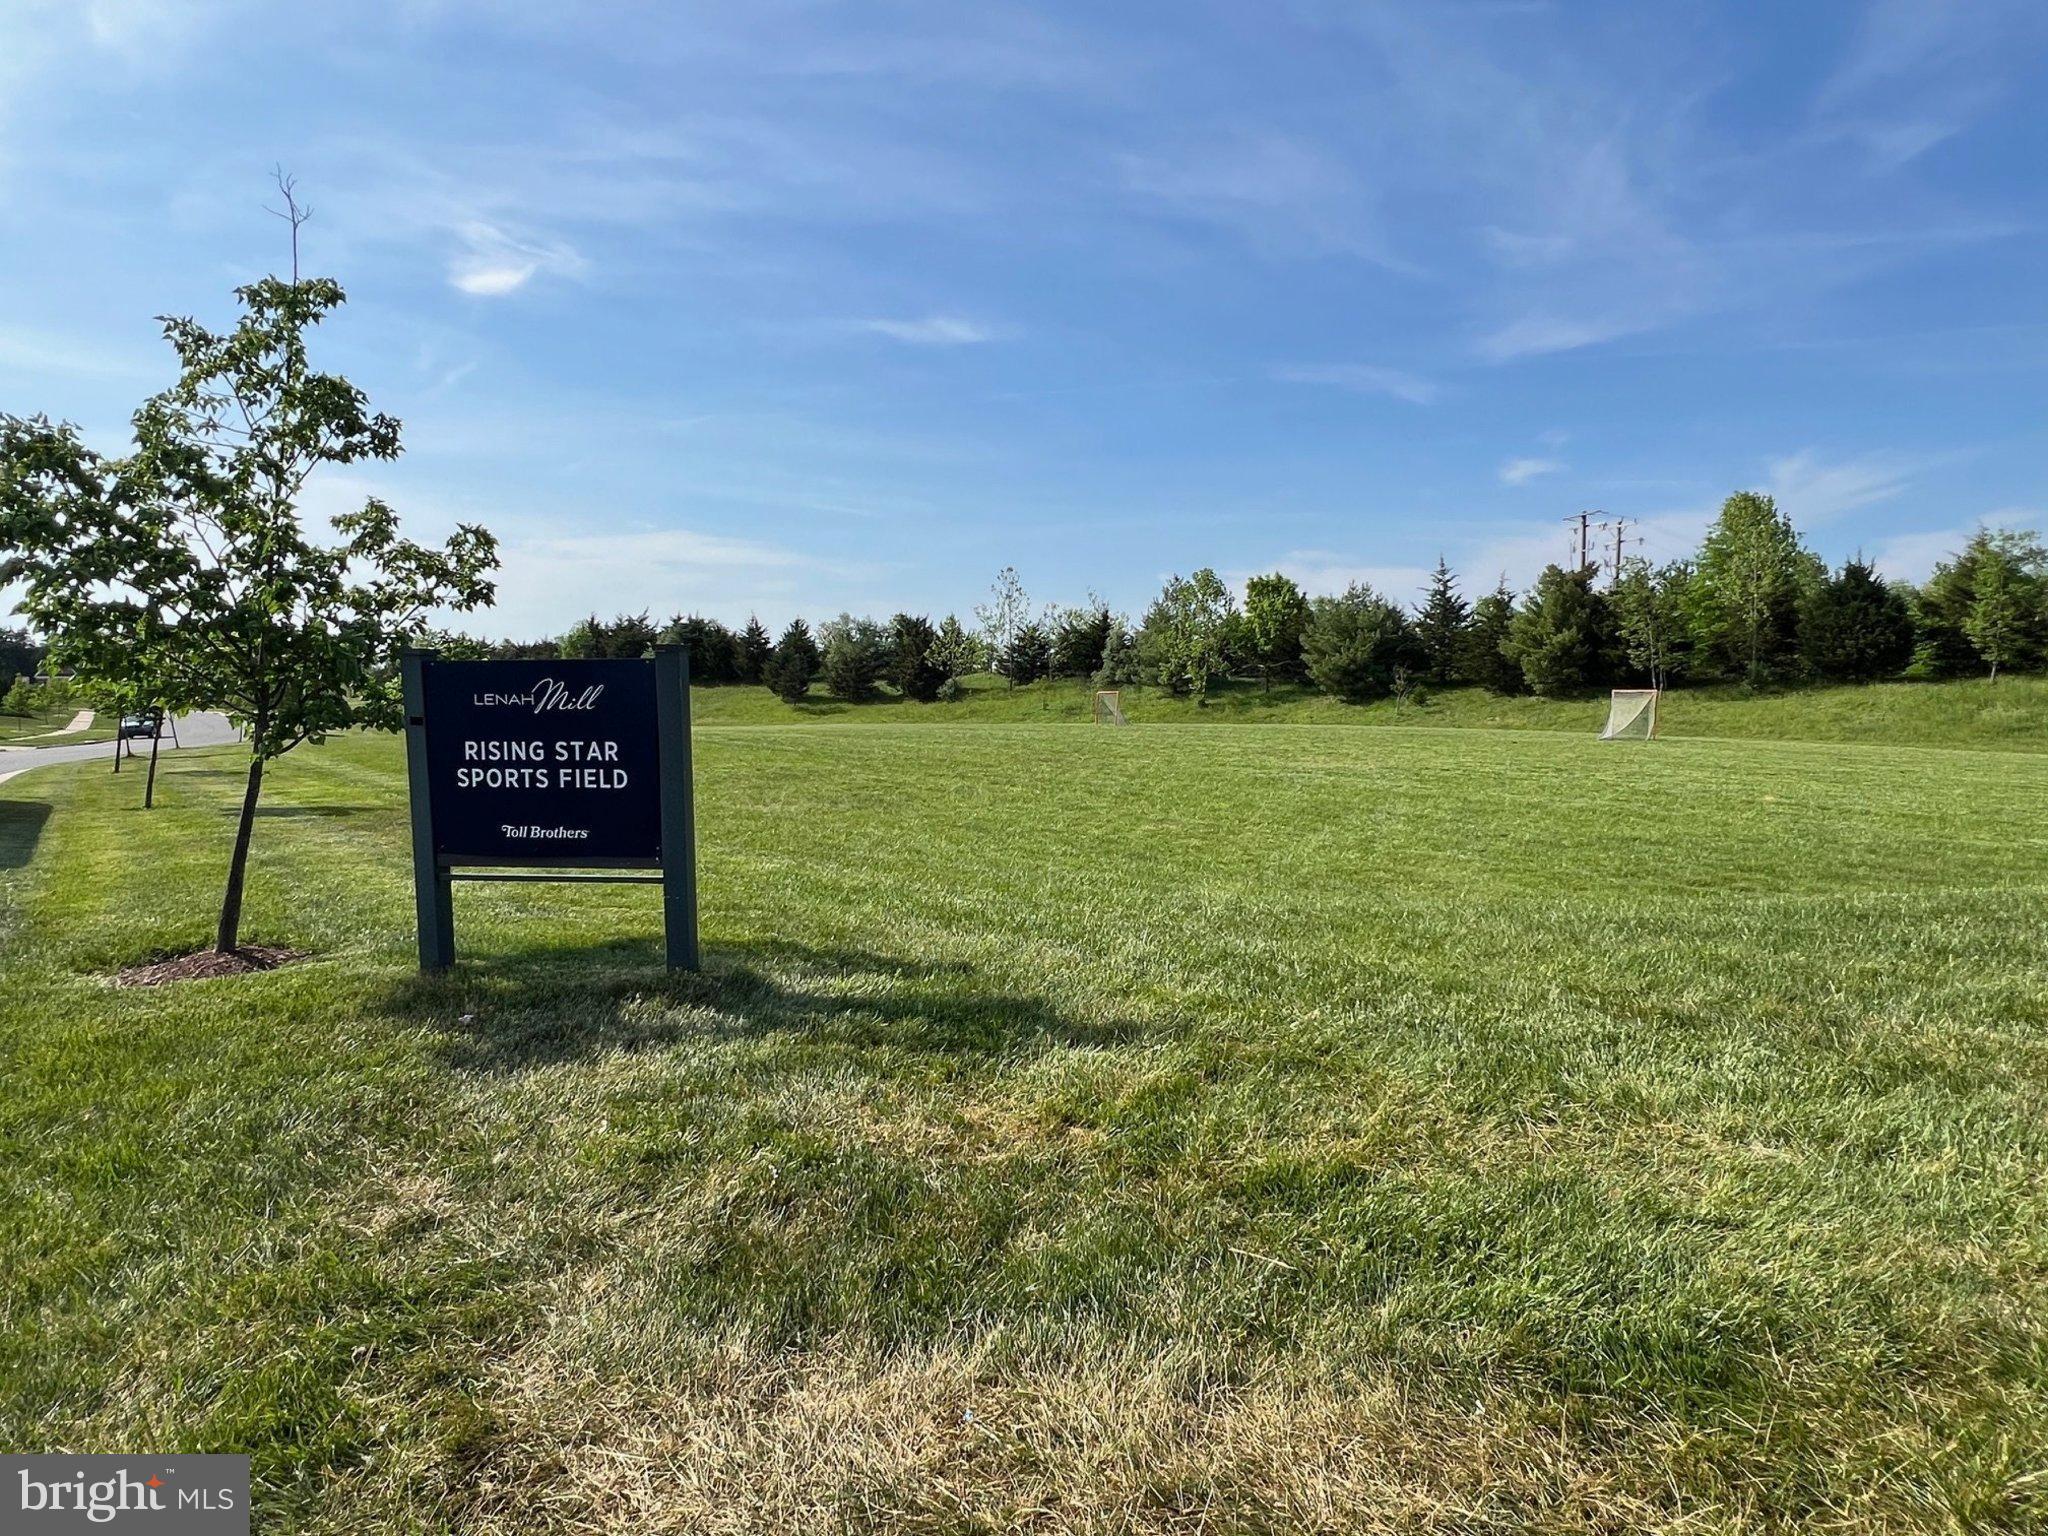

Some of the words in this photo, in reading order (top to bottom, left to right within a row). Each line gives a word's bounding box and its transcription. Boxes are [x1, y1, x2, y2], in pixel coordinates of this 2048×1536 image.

[474, 693, 535, 706] LENAH
[531, 677, 604, 714] Mill
[464, 741, 545, 761] RISING
[555, 741, 619, 762] STAR
[457, 768, 549, 788] SPORTS
[559, 768, 628, 789] FIELD
[501, 824, 528, 838] Toll
[529, 825, 589, 839] Brothers
